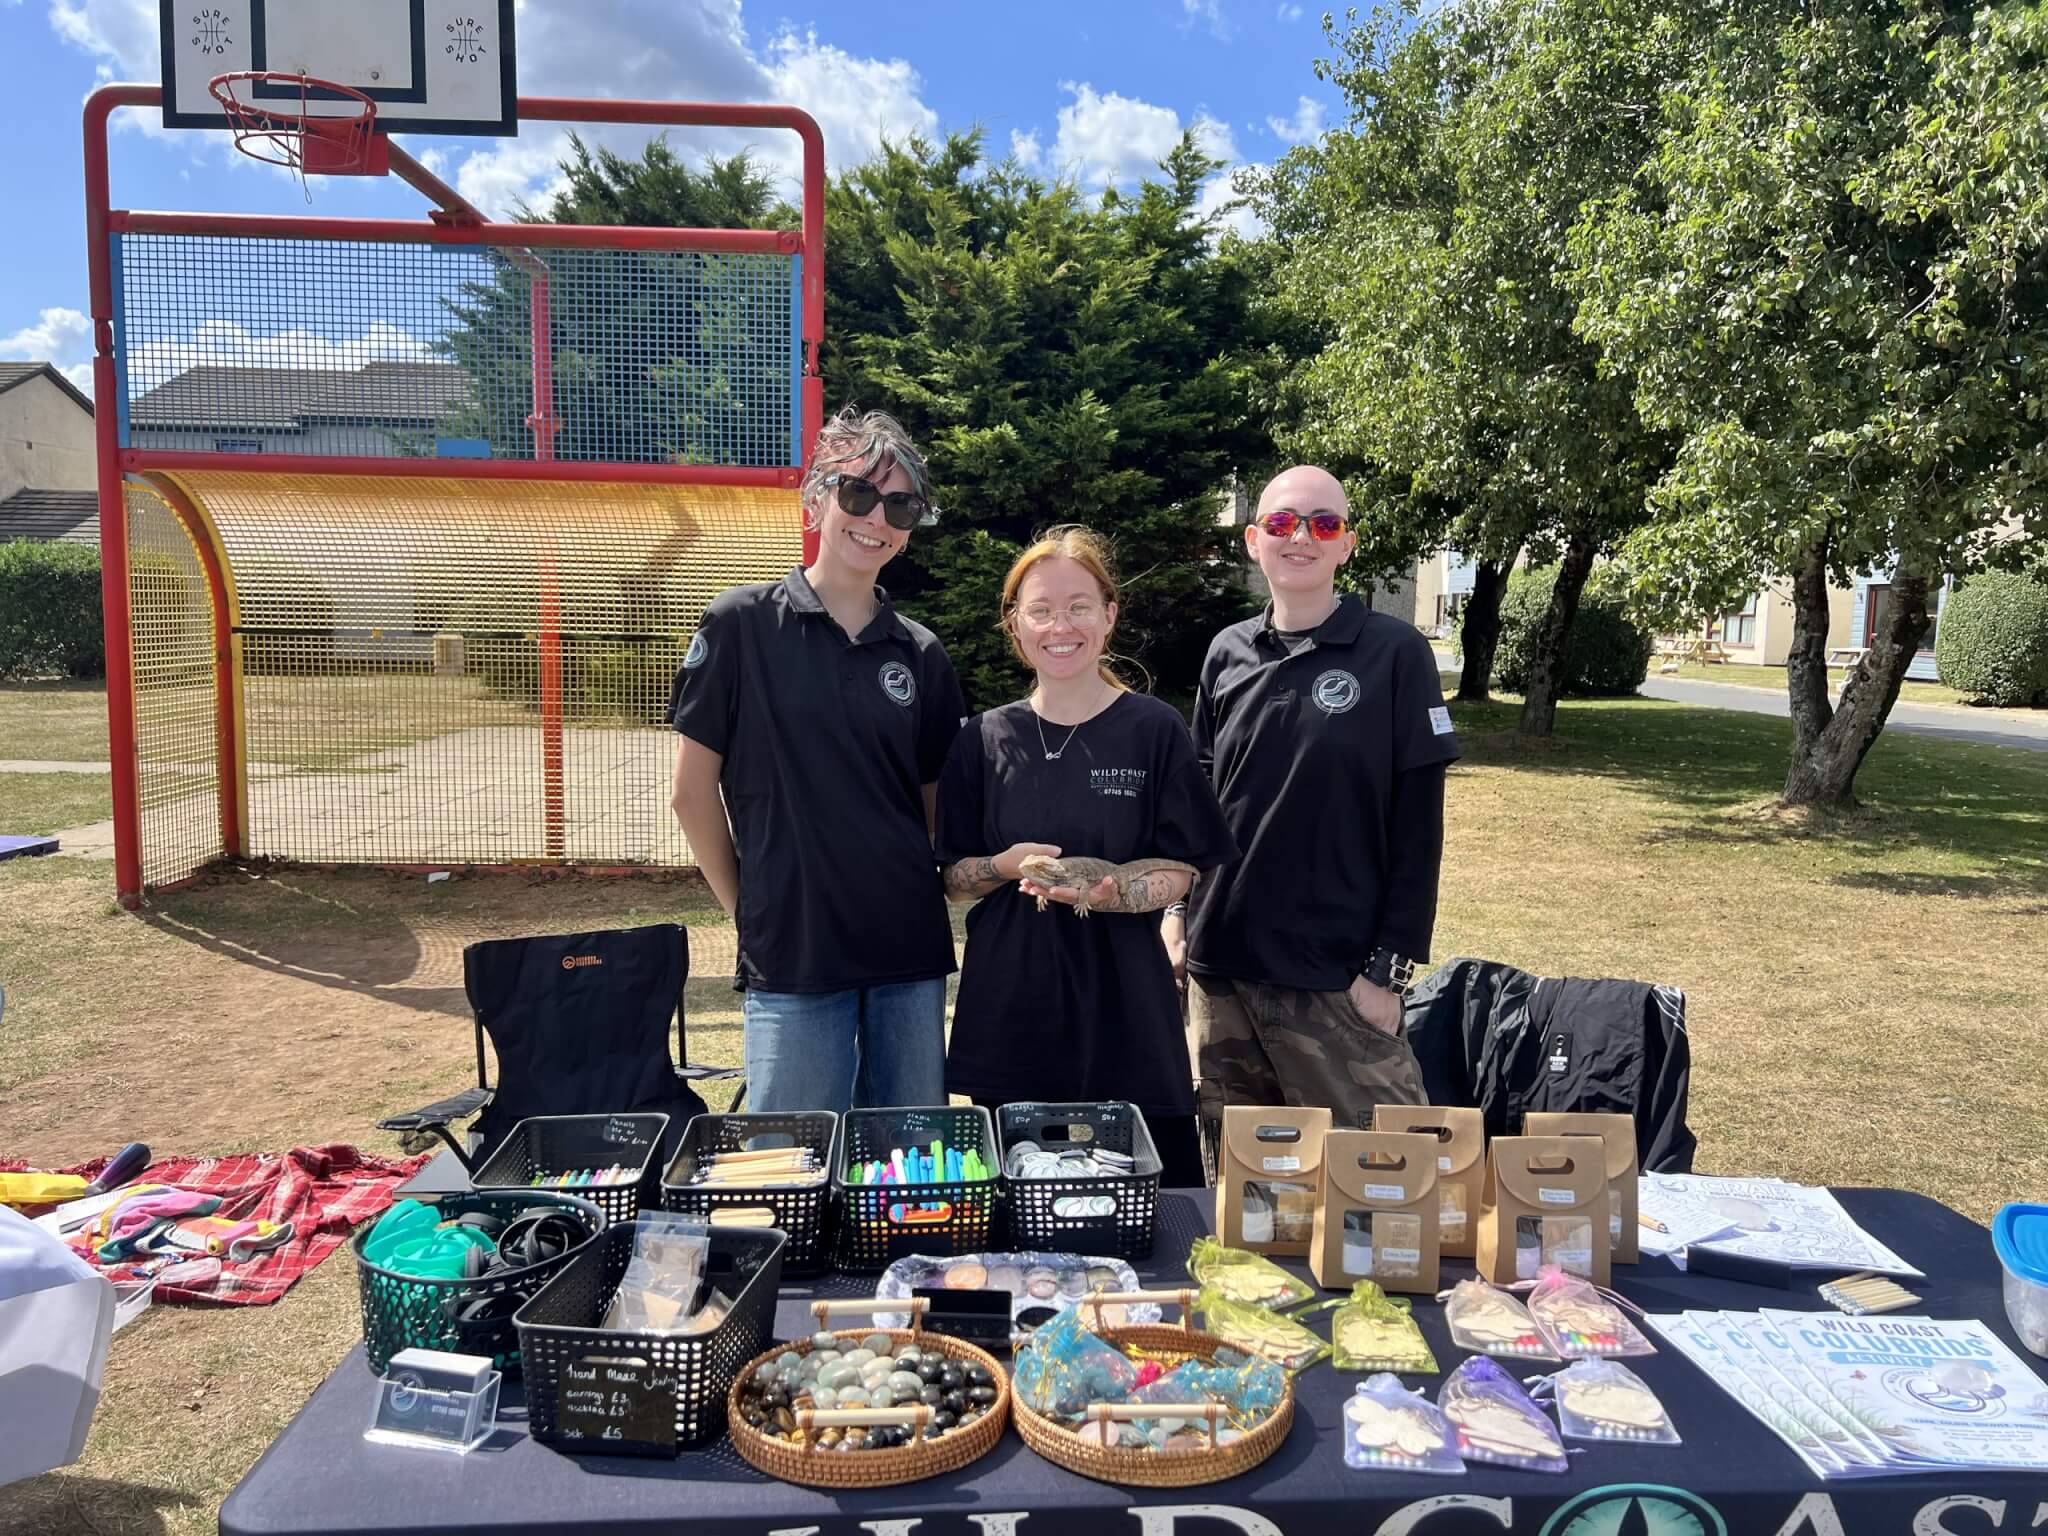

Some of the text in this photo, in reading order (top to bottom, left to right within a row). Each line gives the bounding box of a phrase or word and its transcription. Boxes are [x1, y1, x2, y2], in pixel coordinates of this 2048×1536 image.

[193, 9, 231, 25] SURE
[447, 17, 484, 33] SURE
[192, 36, 233, 55] SHOT
[445, 45, 487, 63] SHOT
[1090, 768, 1119, 777] WILD
[1817, 1319, 1946, 1338] WILD COAST
[1800, 1329, 1993, 1357] COLUBRIDS
[1844, 1353, 1924, 1367] ACTIVITY
